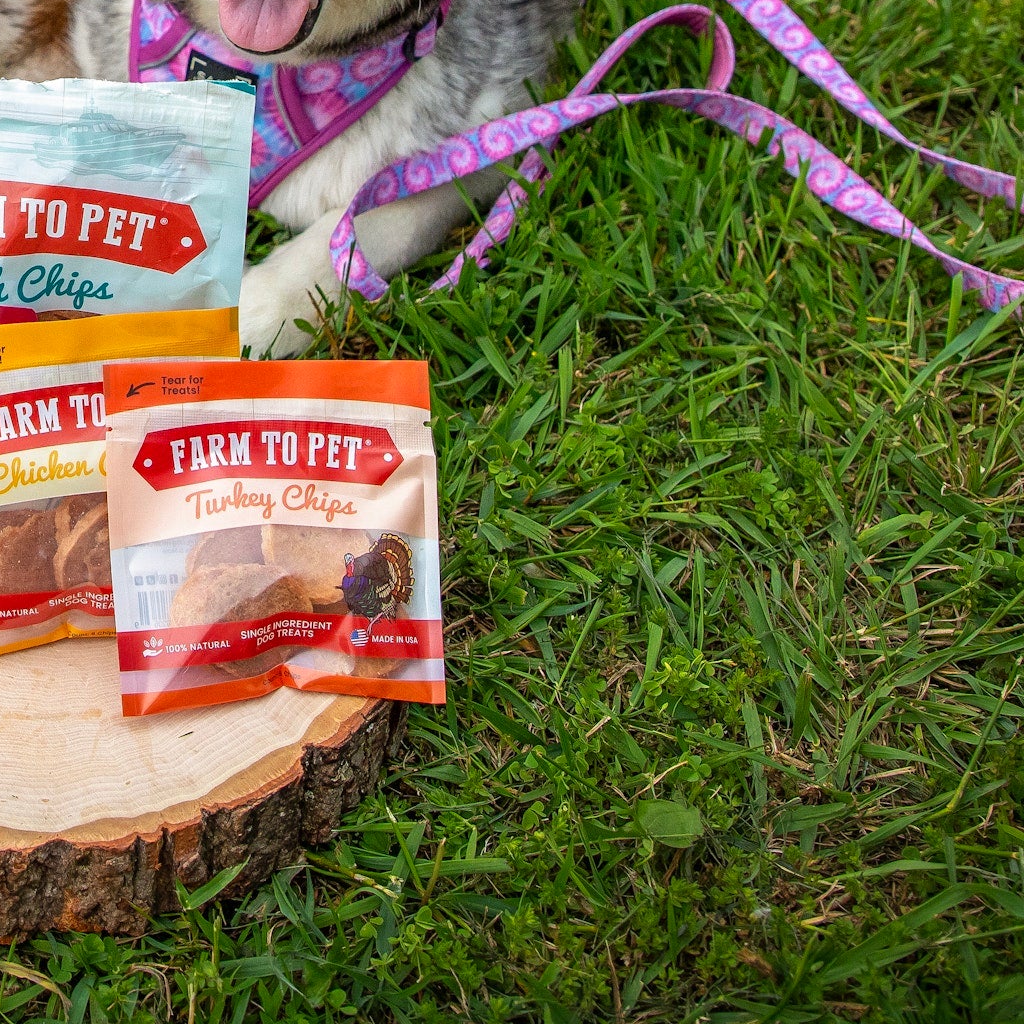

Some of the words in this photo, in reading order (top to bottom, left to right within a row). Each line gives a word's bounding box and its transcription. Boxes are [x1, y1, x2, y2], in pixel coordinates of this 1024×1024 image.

[20, 197, 68, 240] TO
[17, 262, 114, 310] Chips
[161, 376, 186, 385] Tear
[189, 375, 204, 384] for
[161, 386, 200, 395] Treats!
[69, 393, 106, 429] TO
[169, 431, 252, 475] FARM
[261, 431, 299, 466] TO
[185, 481, 276, 520] Turkey
[281, 483, 357, 523] Chips
[48, 592, 83, 607] SINGLE
[65, 598, 88, 606] DOG
[0, 607, 40, 618] NATURAL
[240, 624, 271, 640] SINGLE
[272, 619, 332, 631] INGREDIENT
[256, 632, 275, 646] DOG
[277, 629, 314, 638] TREATS
[165, 644, 187, 653] 100%
[189, 640, 231, 651] NATURAL
[371, 635, 394, 643] MADE
[405, 636, 419, 644] USA
